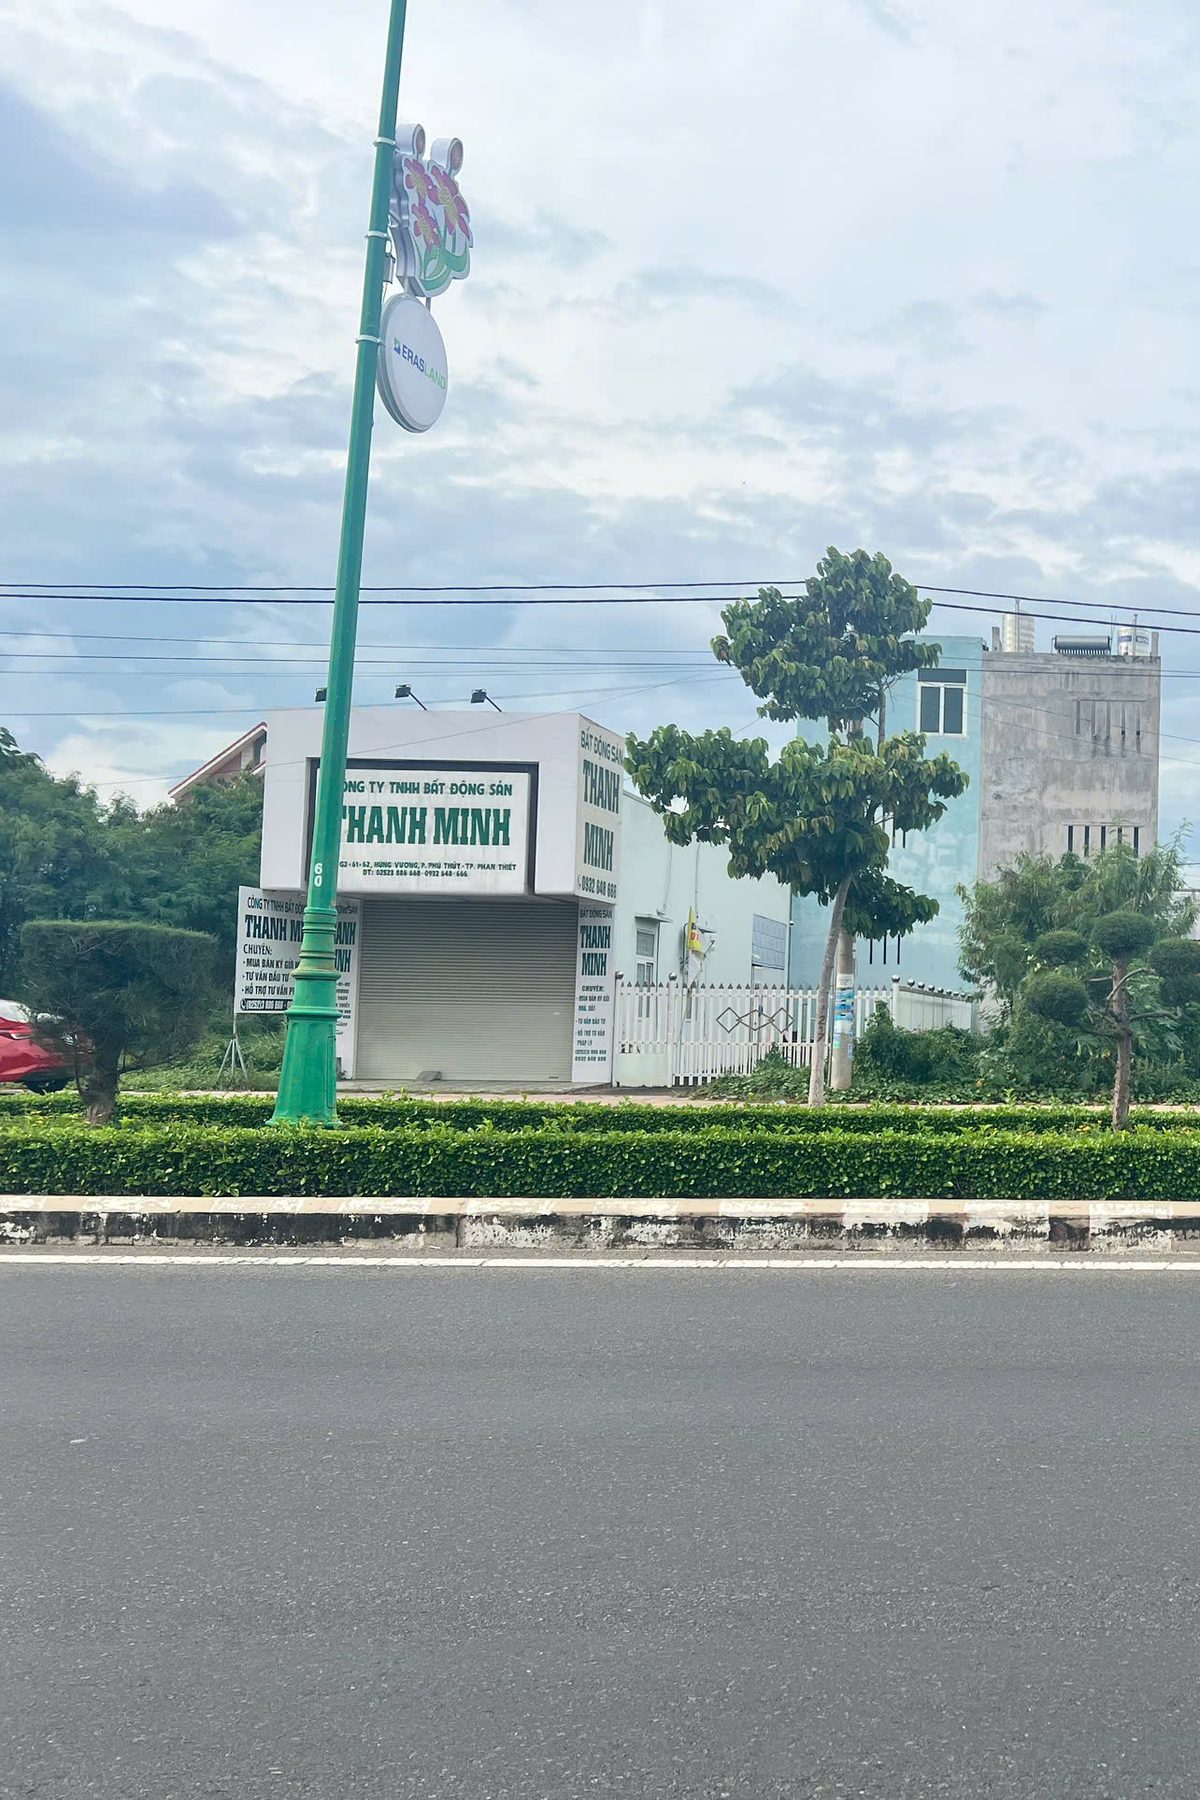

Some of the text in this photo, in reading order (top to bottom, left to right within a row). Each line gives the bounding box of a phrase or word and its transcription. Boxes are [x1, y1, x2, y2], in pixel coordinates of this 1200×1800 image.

[369, 781, 385, 793] TY
[389, 782, 419, 794] TNHH
[424, 778, 445, 795] BẤT
[450, 780, 485, 798] ĐỘNG
[489, 779, 512, 796] SẢN
[583, 759, 620, 814] THANH
[342, 805, 511, 846] HANH MINH
[584, 822, 614, 871] MINH
[245, 915, 287, 940] THANH
[334, 922, 356, 945] ANH
[580, 926, 611, 948] THANH
[582, 953, 607, 976] MINH
